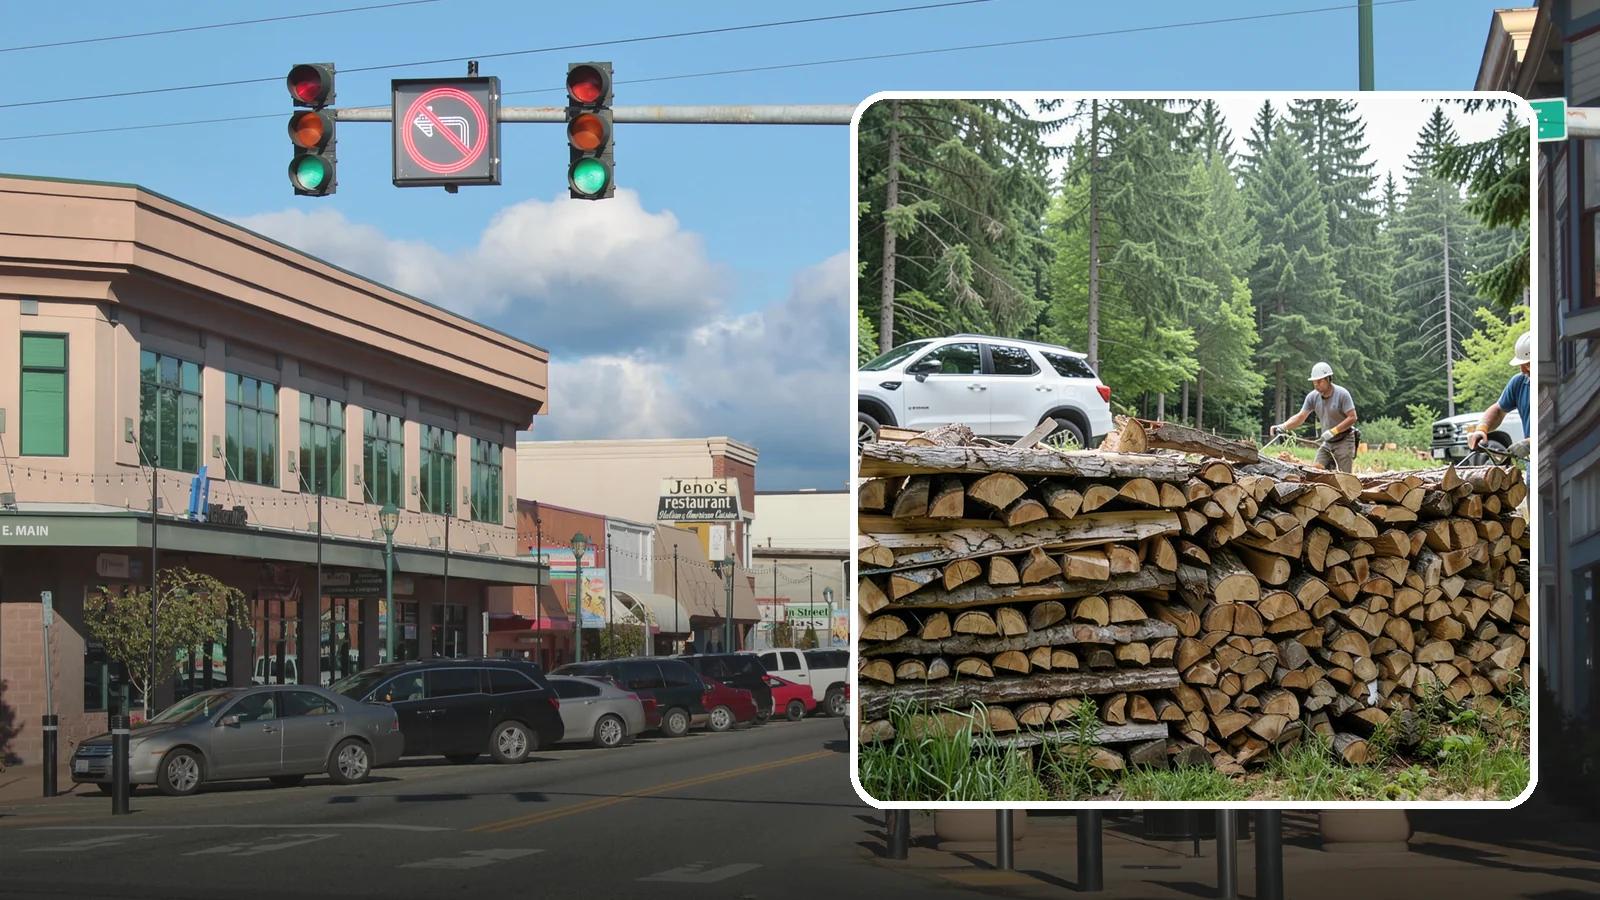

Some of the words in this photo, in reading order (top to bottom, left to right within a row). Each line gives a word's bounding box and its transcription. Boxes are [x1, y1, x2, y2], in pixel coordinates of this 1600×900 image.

[669, 480, 727, 494] Jeno's
[665, 496, 731, 509] restaurant
[686, 509, 714, 519] American
[715, 509, 737, 519] Cuisine
[2, 525, 13, 536] E.
[15, 525, 49, 536] MAIN
[797, 607, 828, 617] Street
